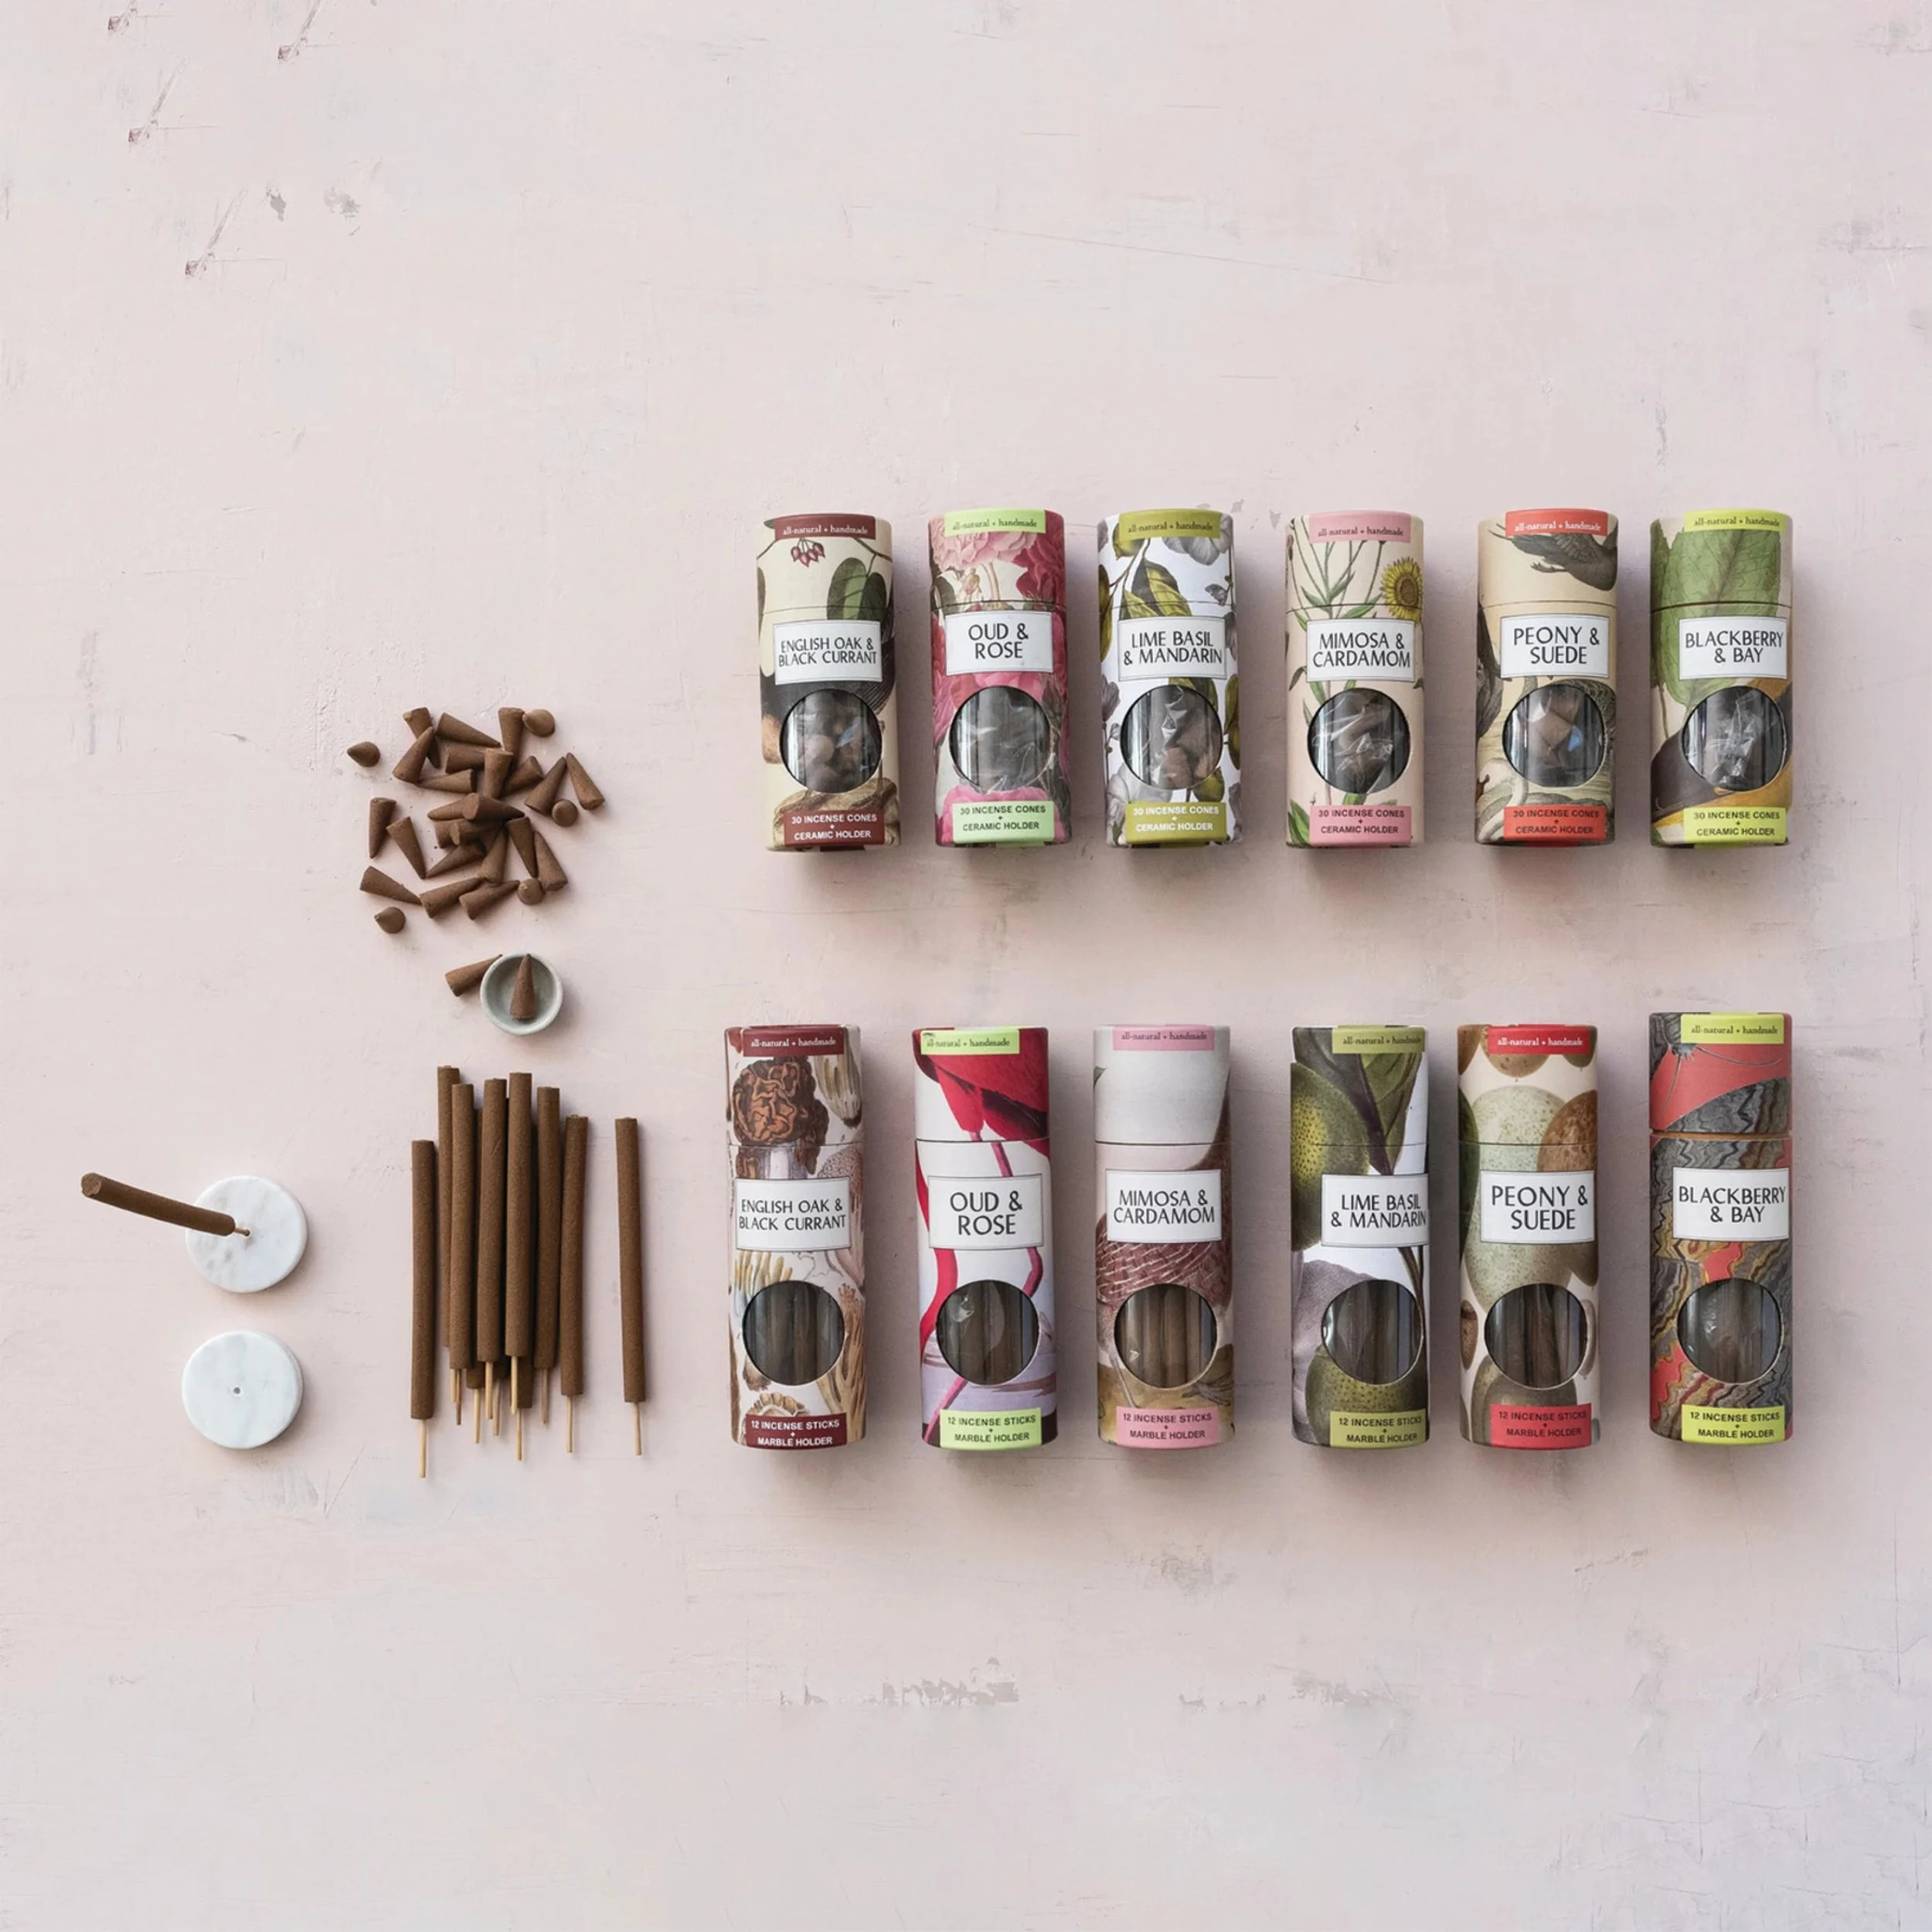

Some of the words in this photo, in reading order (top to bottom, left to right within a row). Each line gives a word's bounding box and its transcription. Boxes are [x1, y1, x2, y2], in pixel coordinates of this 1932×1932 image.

[952, 519, 989, 529] all-natural
[998, 519, 1037, 528] handmade
[1128, 522, 1167, 533] all-natural
[1176, 521, 1213, 531] handmade
[1515, 521, 1556, 532] all-natural
[1563, 521, 1601, 531] handmade
[1693, 517, 1736, 527] all-natural
[1745, 516, 1780, 526] handmade
[782, 524, 822, 536] all-natural
[830, 524, 869, 535] handmade
[1317, 527, 1358, 537] all-natural
[1366, 527, 1404, 536] handmade
[968, 624, 1009, 641] OUD
[1016, 624, 1029, 639] &
[1513, 626, 1583, 646] PEONY
[1590, 628, 1600, 645] &
[781, 637, 830, 651] ENGLISH
[834, 638, 862, 650] OAK
[866, 638, 874, 650] &
[1131, 632, 1167, 648] LIME
[1172, 632, 1214, 647] BASIL
[1319, 632, 1389, 649] MIMOSA
[1396, 634, 1405, 648] &
[1685, 631, 1784, 648] BLACKBERRY
[975, 642, 1023, 659] ROSE
[1530, 646, 1587, 665] SUEDE
[1714, 649, 1726, 663] &
[1733, 648, 1764, 664] BAY
[778, 651, 817, 666] BLACK
[822, 651, 877, 664] CURRANT
[1123, 651, 1133, 665] &
[1139, 648, 1223, 665] MANDARIN
[1312, 651, 1410, 668] CARDAMOM
[960, 806, 970, 815] 30
[971, 805, 1013, 815] INCENSE
[1015, 805, 1046, 814] CONES
[1132, 807, 1144, 816] 30
[1145, 806, 1186, 815] INCENSE
[1188, 806, 1219, 815] CONES
[1318, 810, 1329, 818] 30
[1332, 809, 1373, 818] INCENSE
[1375, 809, 1405, 818] CONES
[1513, 810, 1525, 818] 30
[1571, 810, 1600, 818] CONES
[791, 815, 802, 824] 30
[804, 815, 845, 824] INCENSE
[847, 814, 877, 822] CONES
[1694, 811, 1705, 821] 30
[1707, 811, 1750, 820] INCENSE
[1750, 811, 1781, 820] CONES
[962, 821, 1001, 832] CERAMIC
[1003, 821, 1039, 830] HOLDER
[1136, 822, 1175, 832] CERAMIC
[1177, 821, 1213, 831] HOLDER
[1321, 825, 1361, 835] CERAMIC
[1363, 825, 1399, 834] HOLDER
[1515, 826, 1556, 835] CERAMIC
[1559, 825, 1594, 835] HOLDER
[1696, 828, 1739, 837] CERAMIC
[1740, 827, 1775, 836] HOLDER
[794, 830, 832, 841] CERAMIC
[834, 829, 871, 838] HOLDER
[1121, 1032, 1161, 1041] all-natural
[1169, 1031, 1208, 1041] handmade
[1691, 1026, 1733, 1035] all-natural
[1742, 1026, 1778, 1035] handmade
[750, 1038, 790, 1047] all-natural
[798, 1037, 837, 1046] handmade
[968, 1037, 1010, 1047] handmade
[1342, 1036, 1384, 1046] all-natural
[1497, 1037, 1540, 1046] all-natural
[1548, 1037, 1583, 1046] handmade
[1118, 1190, 1191, 1207] MIMOSA
[1198, 1189, 1208, 1205] &
[1492, 1185, 1571, 1206] PEONY
[1577, 1185, 1589, 1206] &
[1679, 1185, 1787, 1204] BLACKBERRY
[741, 1199, 793, 1214] ENGLISH
[798, 1199, 830, 1213] OAK
[834, 1199, 843, 1213] &
[950, 1192, 1001, 1213] OUD
[1009, 1191, 1023, 1211] &
[1341, 1195, 1381, 1212] LIME
[1386, 1195, 1421, 1210] BASIL
[1113, 1206, 1216, 1225] CARDAMOM
[1331, 1212, 1342, 1227] &
[1349, 1210, 1427, 1228] MANDARIN
[1511, 1209, 1577, 1231] SUEDE
[1709, 1206, 1723, 1223] &
[1731, 1206, 1764, 1223] BAY
[738, 1216, 779, 1230] BLACK
[784, 1215, 846, 1230] CURRANT
[957, 1215, 1017, 1236] ROSE
[947, 1416, 956, 1424] 12
[958, 1416, 1002, 1426] INCENSE
[1005, 1415, 1036, 1425] STICKS
[1123, 1413, 1131, 1421] 12
[1134, 1413, 1177, 1423] INCENSE
[1179, 1413, 1213, 1423] STICKS
[1498, 1411, 1508, 1420] 12
[1510, 1411, 1555, 1421] INCENSE
[1557, 1410, 1587, 1420] STICKS
[1690, 1412, 1699, 1420] 12
[1702, 1412, 1747, 1422] INCENSE
[1749, 1411, 1781, 1421] STICKS
[762, 1420, 804, 1430] INCENSE
[807, 1419, 840, 1429] STICKS
[1338, 1417, 1347, 1426] 12
[1349, 1417, 1393, 1427] INCENSE
[1396, 1417, 1422, 1427] STICKS
[954, 1433, 992, 1443] MARBLE
[994, 1432, 1030, 1442] HOLDER
[1130, 1430, 1168, 1440] MARBLE
[1169, 1429, 1206, 1438] HOLDER
[1506, 1427, 1545, 1437] MARBLE
[1547, 1427, 1582, 1437] HOLDER
[1698, 1427, 1737, 1438] MARBLE
[1739, 1427, 1774, 1437] HOLDER
[757, 1436, 793, 1447] MARBLE
[794, 1436, 833, 1446] HOLDER
[1346, 1434, 1385, 1444] MARBLE
[1387, 1433, 1417, 1443] HOLDER
